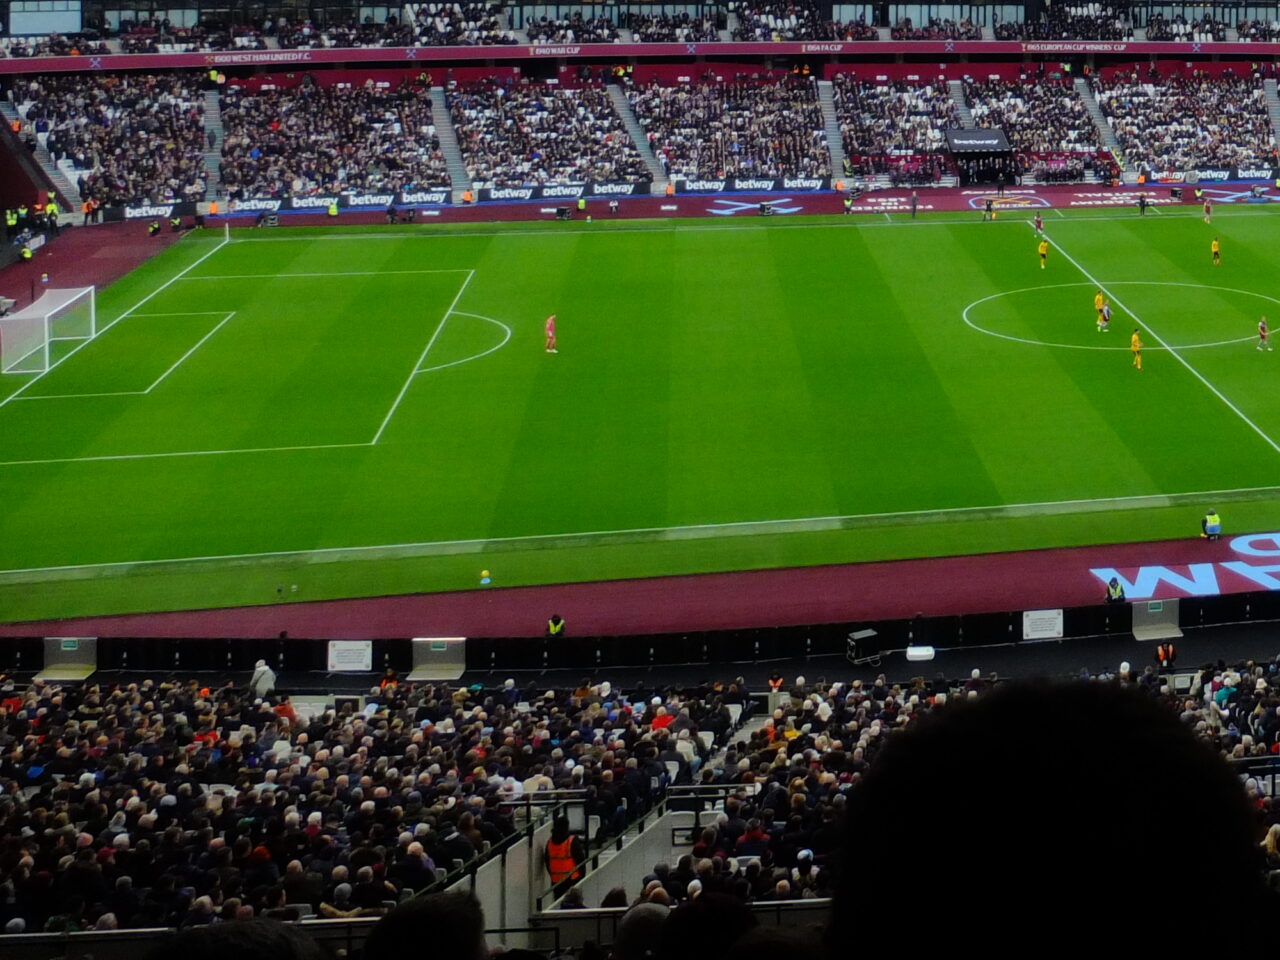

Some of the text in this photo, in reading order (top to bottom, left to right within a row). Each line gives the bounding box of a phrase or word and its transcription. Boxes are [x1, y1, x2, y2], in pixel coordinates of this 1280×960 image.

[232, 54, 251, 62] WEST
[269, 53, 297, 61] UNITED
[954, 138, 999, 146] betway
[1238, 168, 1273, 179] betway
[594, 183, 635, 195] betway
[686, 179, 726, 191] betway
[735, 178, 775, 190] betway
[784, 178, 823, 190] betway
[402, 191, 446, 203] betway
[490, 188, 533, 200] betway
[543, 185, 584, 197] betway
[235, 199, 281, 212] betway
[292, 196, 339, 208] betway
[350, 194, 394, 206] betway
[125, 205, 174, 219] betway
